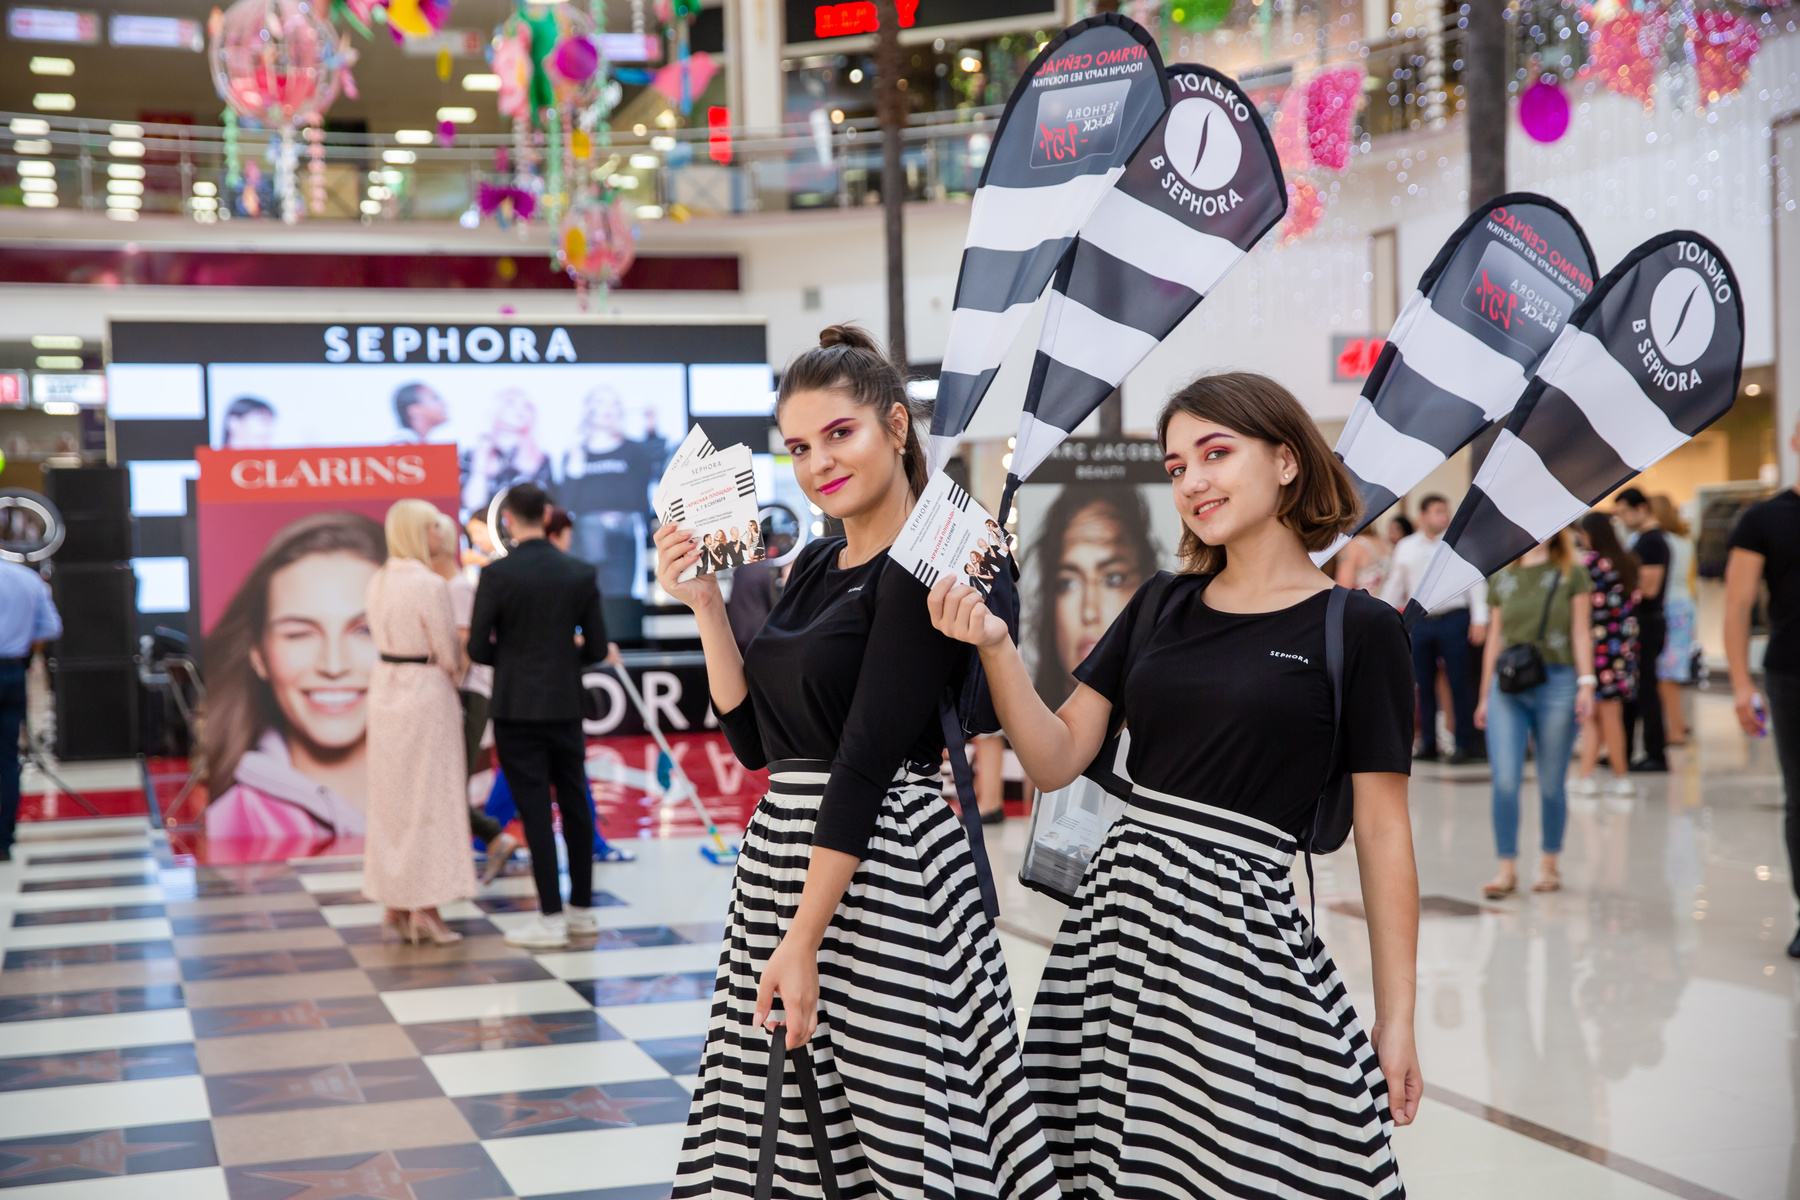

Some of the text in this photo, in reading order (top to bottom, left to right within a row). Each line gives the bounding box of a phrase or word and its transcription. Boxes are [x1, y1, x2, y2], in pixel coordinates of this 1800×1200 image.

[1174, 73, 1250, 122] ТОЛЬКО
[1150, 155, 1244, 216] В SEPHORA
[1677, 240, 1732, 304] ТОЛЬКО
[324, 326, 578, 363] SEPHORA
[1632, 318, 1702, 392] В SEPHORA
[230, 454, 427, 489] CLARINS
[691, 461, 722, 475] SEPHORA
[910, 499, 931, 532] SEPHORA
[1270, 650, 1309, 665] SEPHORA
